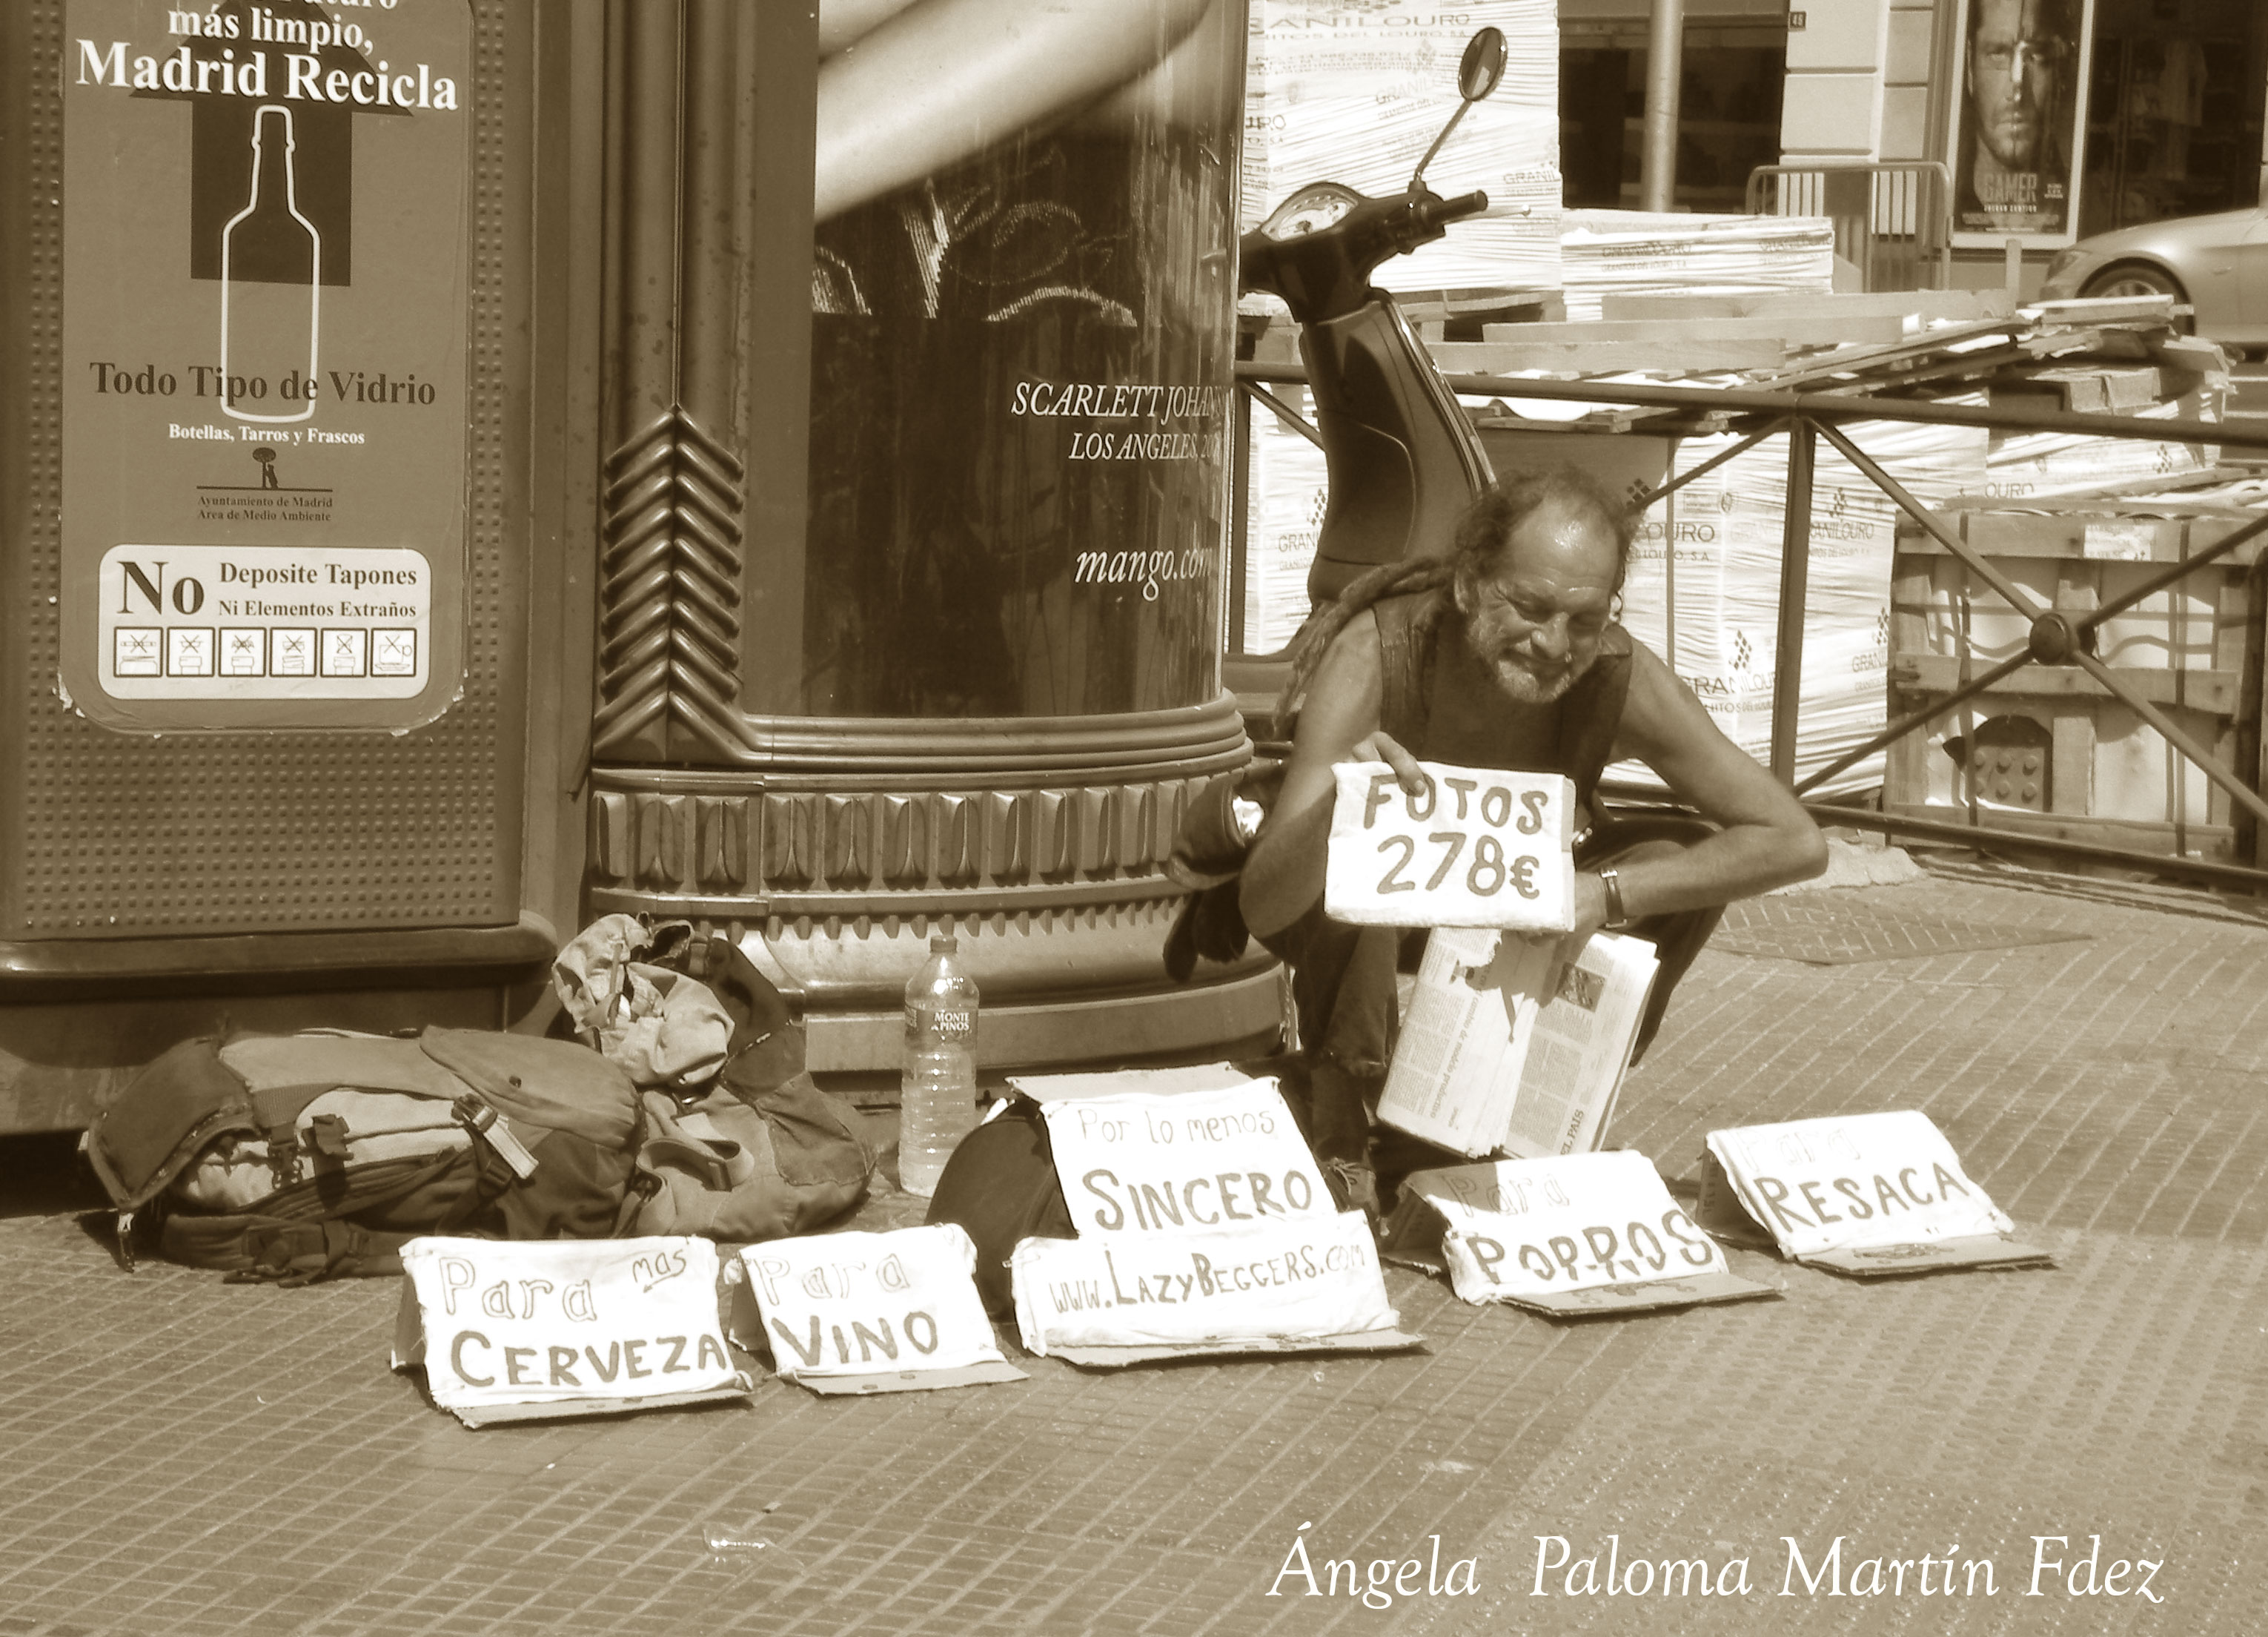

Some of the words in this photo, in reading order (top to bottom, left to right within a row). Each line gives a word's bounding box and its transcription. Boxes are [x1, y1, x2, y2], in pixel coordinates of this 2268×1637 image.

[168, 4, 240, 39] más
[251, 7, 374, 56] limpio,
[76, 39, 269, 98] Madrid
[284, 53, 458, 111] Recicla
[90, 362, 177, 397] Todo
[188, 365, 268, 406] Tipo
[279, 369, 319, 401] de
[328, 371, 436, 405] Vidrio
[1011, 382, 1164, 417] SCARLETT
[169, 423, 234, 442] Botellas,
[239, 426, 289, 443] Tarros
[293, 433, 304, 446] y
[307, 428, 365, 444] Frascos
[1069, 432, 1115, 460] LOS
[198, 496, 273, 508] Ayuntamiento
[276, 497, 289, 507] de
[293, 497, 333, 508] Madrid
[227, 509, 240, 520] de
[244, 509, 277, 520] Medio
[281, 512, 331, 521] Ambiente
[116, 560, 205, 616] No
[219, 562, 318, 589] Deposite
[325, 563, 417, 589] Tapones
[1074, 547, 1213, 602] mango.com
[219, 600, 239, 617] Ni
[245, 601, 334, 618] Elementos
[340, 601, 417, 618] Extraños
[1363, 773, 1548, 835] FOTOS
[1376, 831, 1540, 899] 278€
[934, 1012, 970, 1022] MONTE
[940, 1022, 970, 1031] PINOS
[1078, 1107, 1130, 1142] Por
[1145, 1110, 1174, 1144] lo
[1187, 1108, 1276, 1143] menos
[1082, 1168, 1312, 1231] SINCERO
[1441, 1173, 1571, 1219] Para
[1754, 1163, 1970, 1233] RESACA
[438, 1256, 598, 1323] Para
[633, 1249, 687, 1283] mas
[758, 1253, 911, 1306] Para
[451, 1331, 727, 1388] CERVEZA
[770, 1310, 939, 1366] VINO
